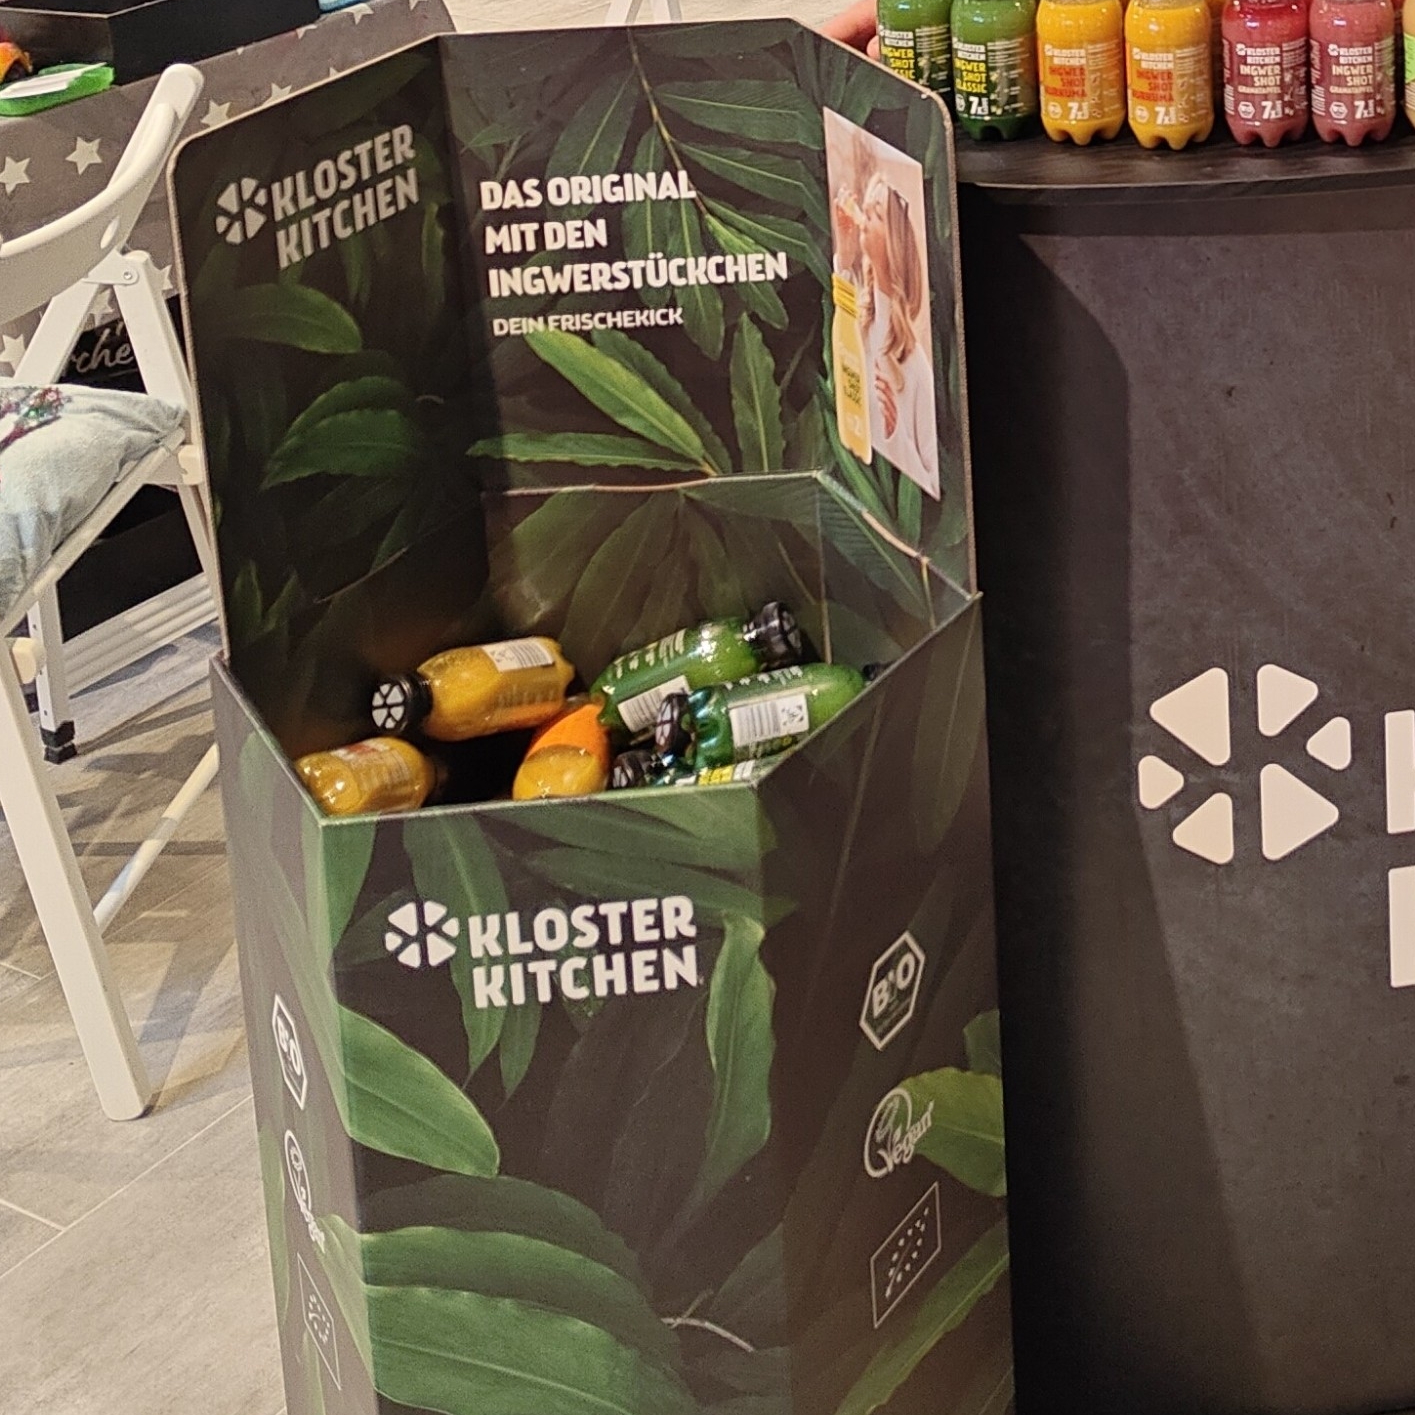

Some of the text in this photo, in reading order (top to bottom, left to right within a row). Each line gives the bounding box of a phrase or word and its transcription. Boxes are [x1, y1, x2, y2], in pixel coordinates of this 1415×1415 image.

[1240, 65, 1281, 76] INGWER
[1253, 76, 1281, 86] SHOT
[1332, 65, 1373, 76] INGWER
[1346, 75, 1373, 86] SHOT
[272, 123, 416, 221] KLOSTER
[480, 170, 698, 211] DAS ORIGINAL
[276, 166, 420, 272] KITCHEN
[484, 218, 608, 255] MIT DEN
[488, 247, 789, 299] INGWERSTÜCKCHEN
[492, 307, 684, 338] DEIN FRISCHEKICK
[467, 895, 698, 960] KLOSTER
[472, 945, 699, 1009] KITCHEN
[872, 952, 916, 1019] BIO
